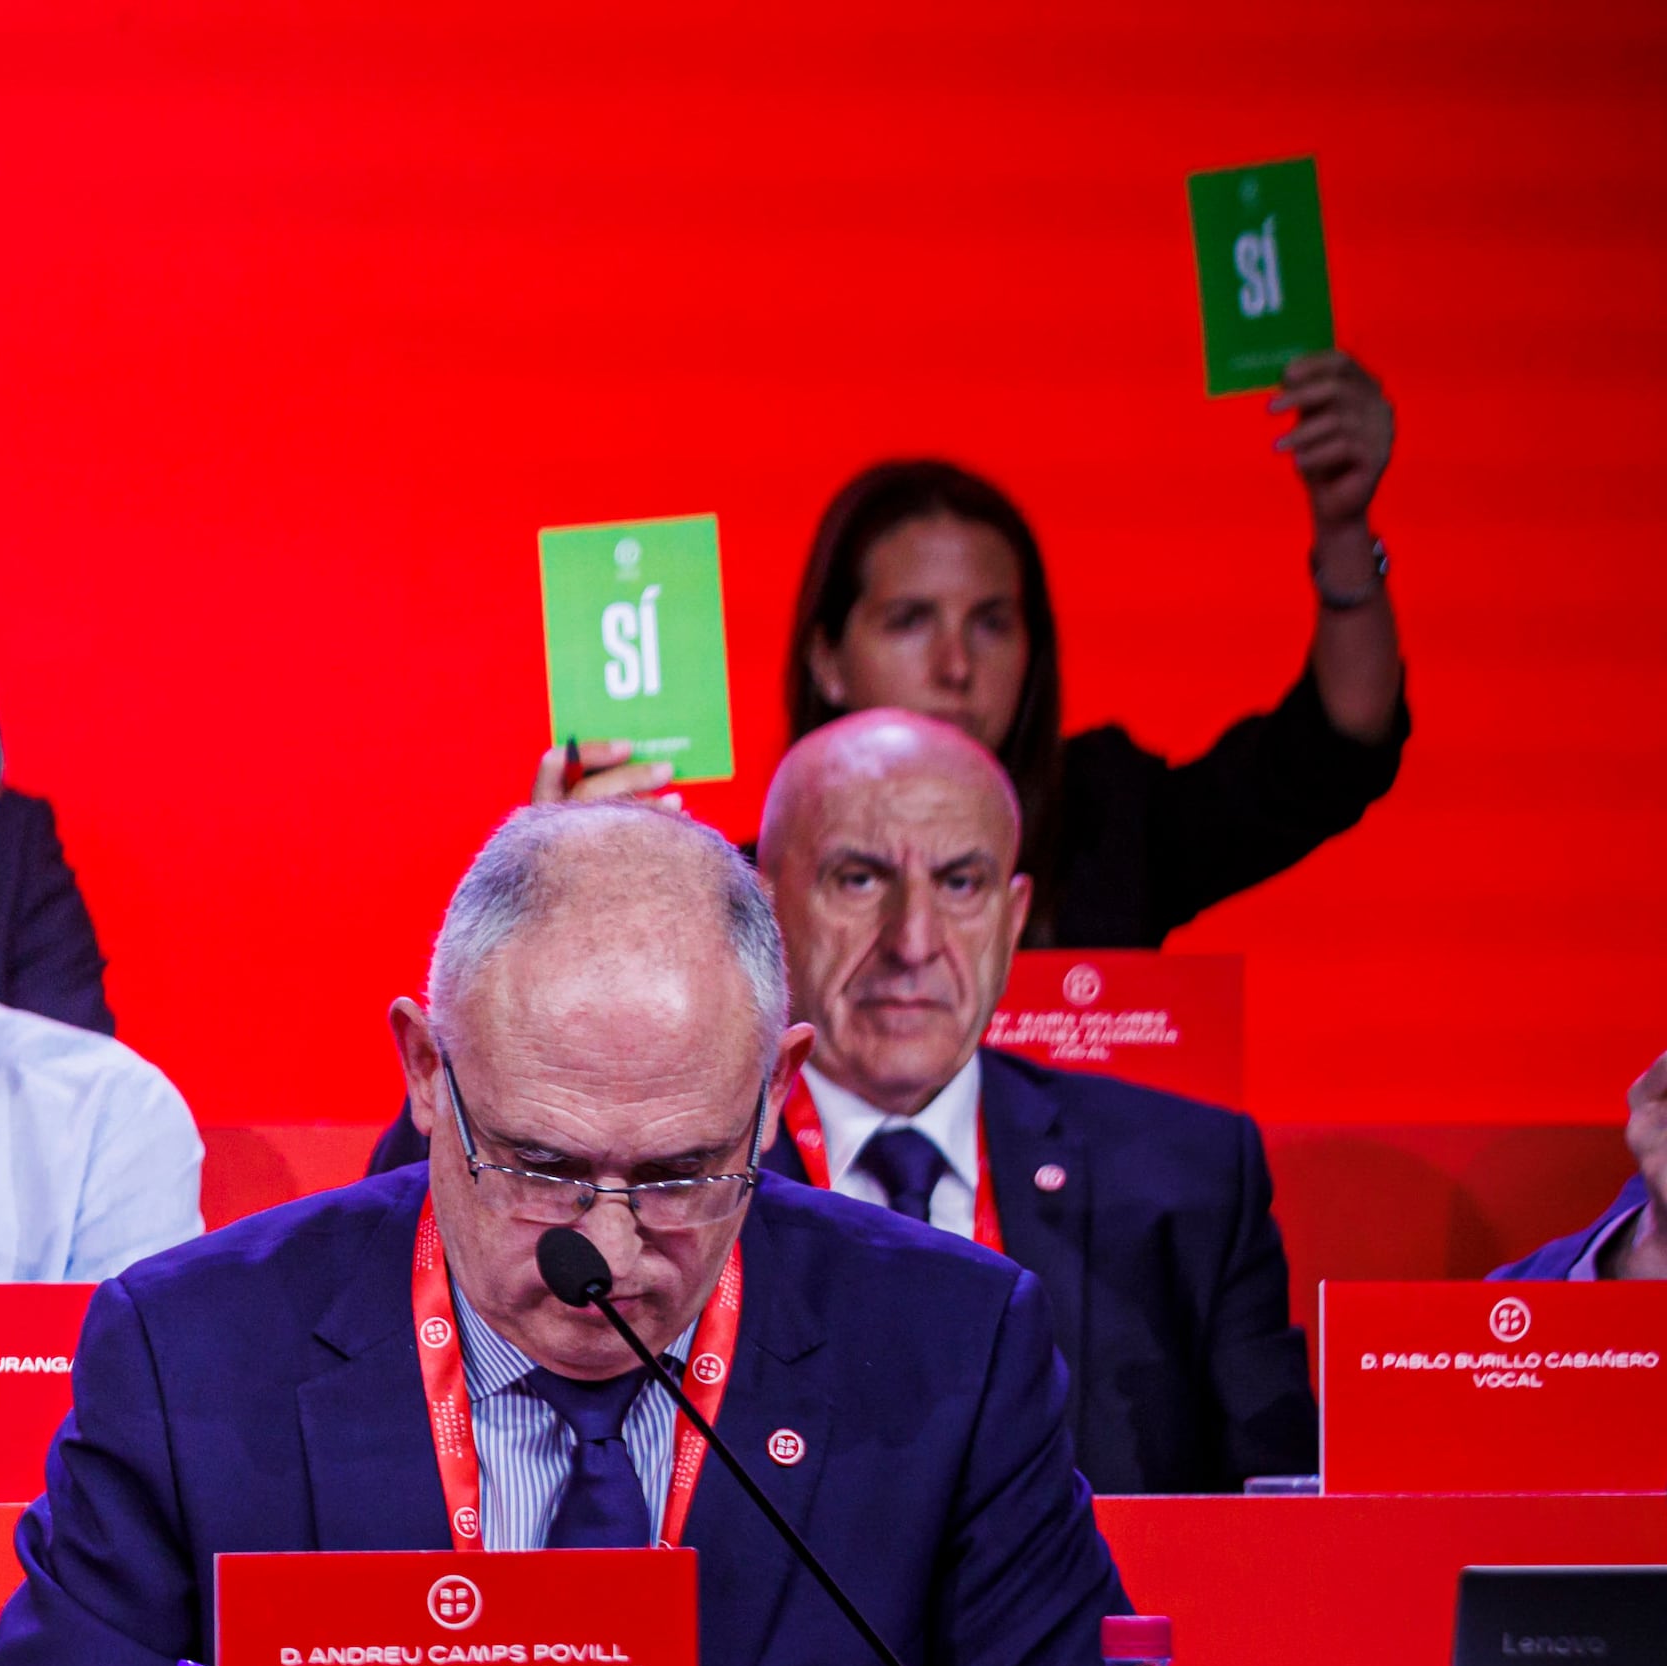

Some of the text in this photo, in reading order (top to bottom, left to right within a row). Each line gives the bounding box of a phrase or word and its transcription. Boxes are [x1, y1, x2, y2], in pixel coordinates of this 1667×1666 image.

[1235, 216, 1283, 317] SÍ
[601, 584, 662, 700] SÍ
[1361, 1349, 1660, 1370] D. PABLO BURILLO CABAÑERO
[1472, 1371, 1544, 1389] VOCAL
[280, 1643, 629, 1666] D. ANDREU CAMPS POVILL
